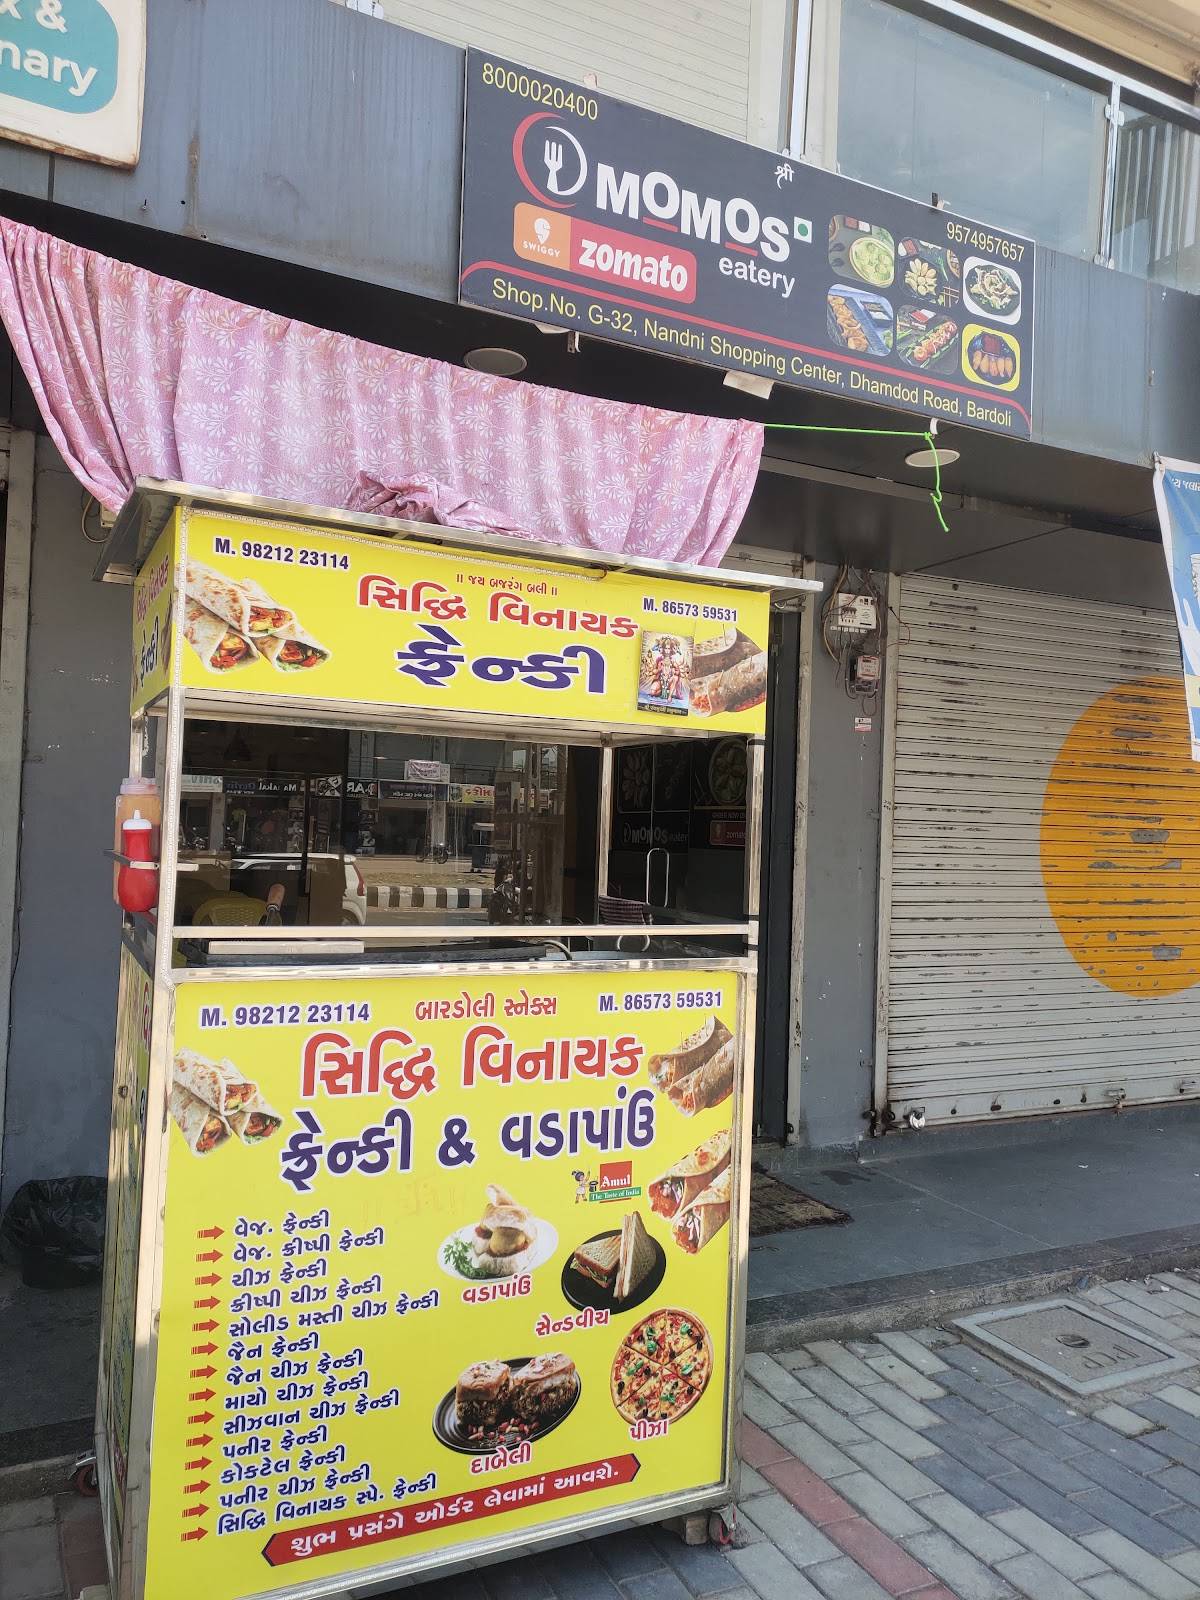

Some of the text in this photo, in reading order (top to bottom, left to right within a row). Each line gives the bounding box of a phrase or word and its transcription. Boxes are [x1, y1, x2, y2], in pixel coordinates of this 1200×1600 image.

[35, 0, 68, 33] &
[0, 41, 98, 97] nary
[482, 63, 599, 120] 8000020400
[774, 162, 794, 189] श्री
[522, 240, 560, 258] SWIGGY
[946, 222, 1025, 262] 9574957657
[578, 239, 688, 291] zomato
[718, 257, 795, 298] eatery
[588, 305, 638, 336] G-32,
[644, 318, 705, 351] Nandni
[710, 336, 786, 375] Shopping
[791, 357, 845, 388] Center,
[850, 371, 919, 404] Dhamdod
[924, 390, 962, 416] Road,
[967, 401, 1012, 427] Bardoli
[215, 537, 349, 570] M. 98212 23114
[468, 575, 485, 586] જય
[489, 576, 523, 592] બજરંગ
[526, 582, 547, 595] બલી
[358, 574, 639, 638] સિદ્ધિ વિનાયક
[643, 597, 737, 622] M. 86573 59531
[397, 623, 605, 694] ફ્રેન્કી
[201, 1003, 370, 1027] M. 98212 23114
[415, 989, 557, 1020] બારડોલી સ્નેક્સ
[599, 991, 722, 1012] M. 86573 59531
[303, 1025, 643, 1100] સિદ્ધિ વિનાયક
[281, 1086, 655, 1191] ફ્રેન્કી & વડાપાંઉ
[591, 1192, 603, 1201] The
[604, 1191, 618, 1199] Taste
[625, 1189, 640, 1197] India
[601, 1174, 631, 1188] Amul
[234, 1210, 329, 1237] વેજ. ફ્રેન્કી
[233, 1243, 272, 1262] વેજ.
[340, 1228, 384, 1251] ફ્રેન્કી
[232, 1259, 327, 1287] ચીઝ ફ્રેન્કી
[290, 1285, 327, 1304] ચીઝ
[336, 1275, 382, 1299] ફ્રેન્કી
[463, 1275, 531, 1303] વડાપાંઉ
[229, 1290, 439, 1338] સોલીડ મસ્તી ચીઝ ફ્રેન્કી
[536, 1309, 610, 1336] સેન્ડવીચ
[227, 1332, 319, 1361] જૈન ફ્રેન્કી
[226, 1349, 363, 1386] જૈન ચીઝ ફ્રેન્કી
[225, 1371, 368, 1410] માયો ચીઝ ફ્રેન્કી
[224, 1389, 399, 1435] સીઝવાન ચીઝ ફ્રેન્કી
[222, 1425, 327, 1459] પનીર ફ્રેન્કી
[630, 1419, 668, 1440] પીઝા
[221, 1445, 345, 1484] કોકટેલ ફ્રેન્કી
[471, 1443, 532, 1474] દાબેલી
[219, 1464, 370, 1508] પનીર ચીઝ ફ્રેન્કી
[218, 1473, 436, 1534] સિદ્ધિ વિનાયક સ્પે. ફ્રેન્કી
[291, 1462, 619, 1557] શુભ પ્રસંગે ઓર્ડર લેવામાં આવશે.
